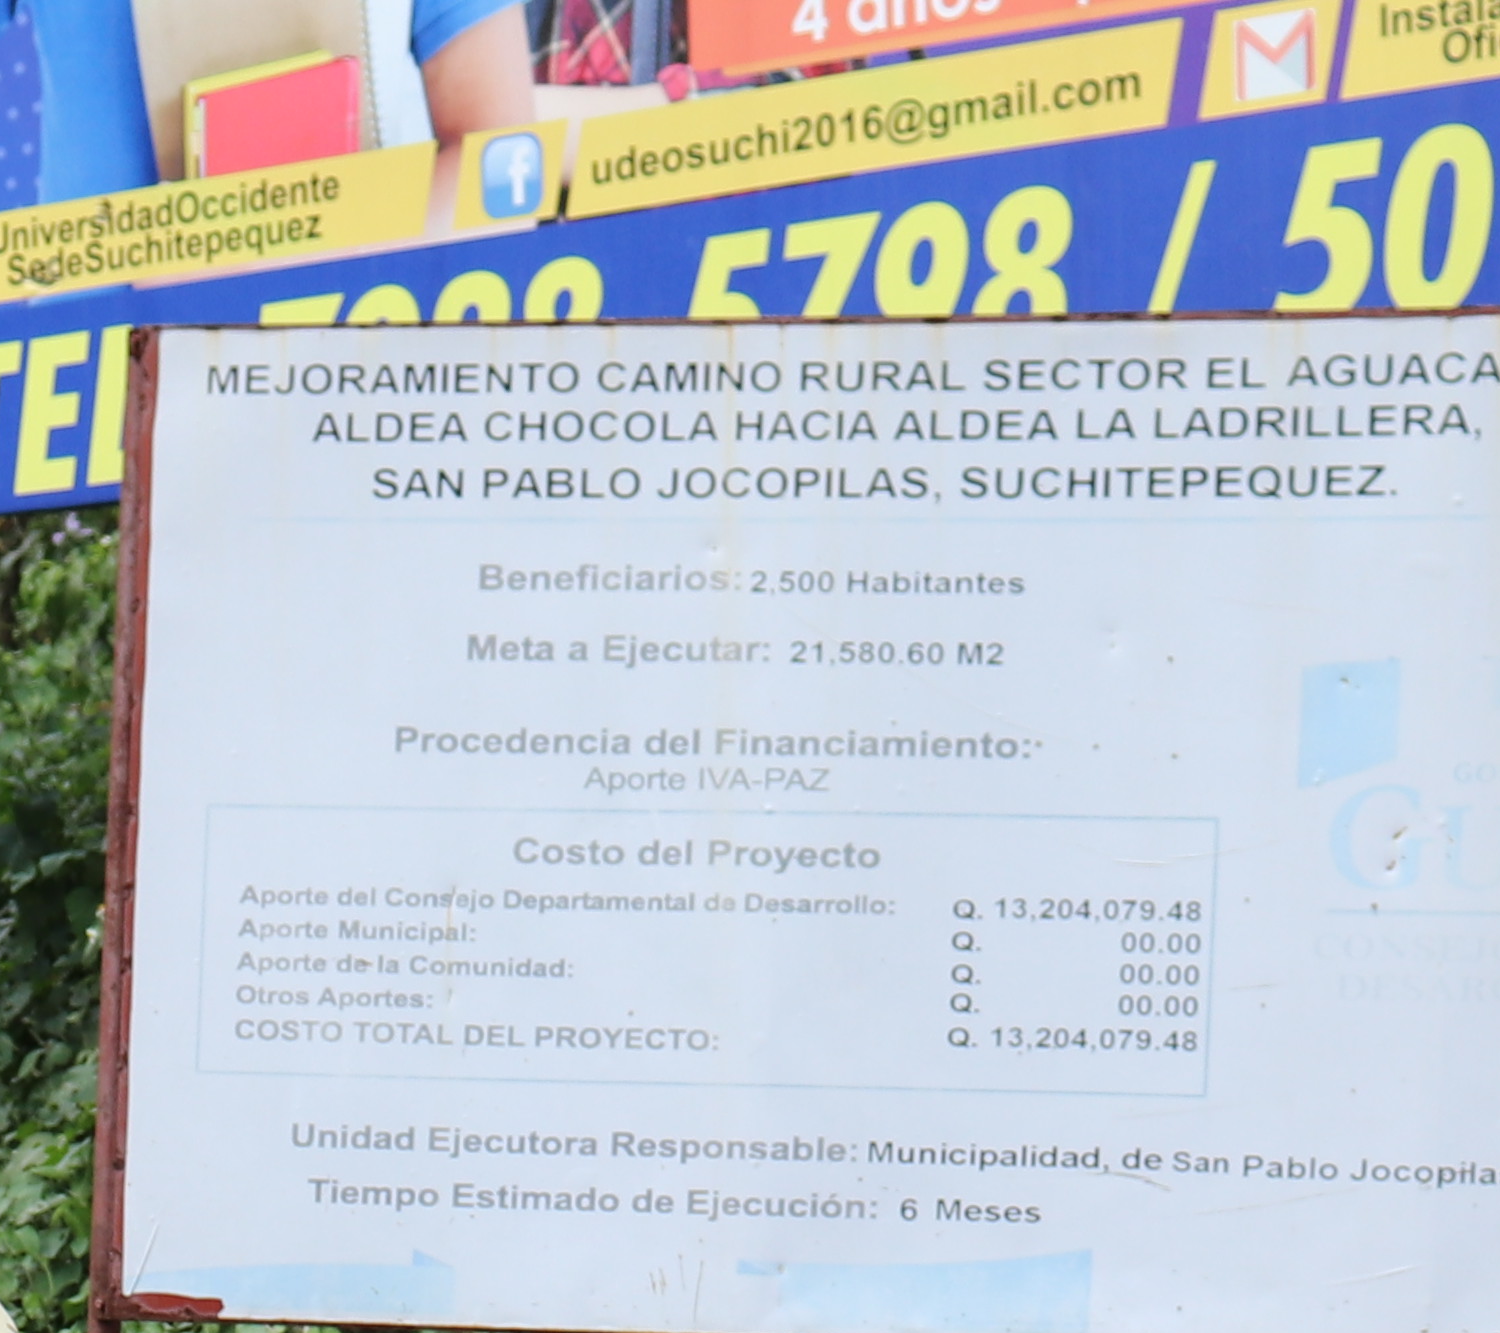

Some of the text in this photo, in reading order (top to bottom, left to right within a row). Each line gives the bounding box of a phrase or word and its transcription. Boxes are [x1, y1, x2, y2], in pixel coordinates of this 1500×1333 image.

[592, 66, 1142, 186] udeosuchi2016@gmail.com
[7, 213, 322, 287] SedeSuchitepequez
[207, 361, 580, 395] MEJORAMIENTO
[597, 361, 782, 393] CAMINO
[800, 360, 965, 393] RURAL
[984, 358, 1187, 392] SECTOR
[1206, 357, 1265, 389] EL
[312, 403, 1481, 443] ALDEA CHOCOLA HACIA ALDEA LA LADRILLERA,
[373, 465, 1396, 501] SAN PABLO JOCOPILAS, SUCHITEPEQUEZ.
[478, 563, 1026, 595] Beneficiarios: 2,500 Habitantes
[467, 634, 1004, 670] Meta a Ejecutar: 21,580.60 M2
[394, 725, 1031, 760] Procedencia del Financiamiento:
[583, 766, 830, 796] Aporte IVA-PAZ
[513, 837, 881, 875] Costo del Proyecto
[239, 884, 1202, 923] Aporte del Consejo Departamental de Desarrollo: Q. 13,204,079.48
[237, 918, 1202, 955] Aporte Municipal: Q. 00.00
[236, 951, 1201, 987] Aporte de la Comunidad: Q. 00.00
[235, 984, 1199, 1018] Otros Aportes: Q. 00.00
[234, 1018, 1198, 1053] COSTO TOTAL DEL PROYECTO: Q. 13,204,079.48
[291, 1123, 415, 1151] Unidad
[428, 1126, 598, 1159] Ejecutora
[611, 1131, 858, 1165] Responsable:
[868, 1140, 1109, 1174] Municipalidad,
[1121, 1147, 1163, 1171] de
[1172, 1151, 1230, 1174] San
[1242, 1154, 1339, 1181] Pablo
[307, 1178, 1042, 1224] Tiempo Estimado de Ejecución: 6 Meses
